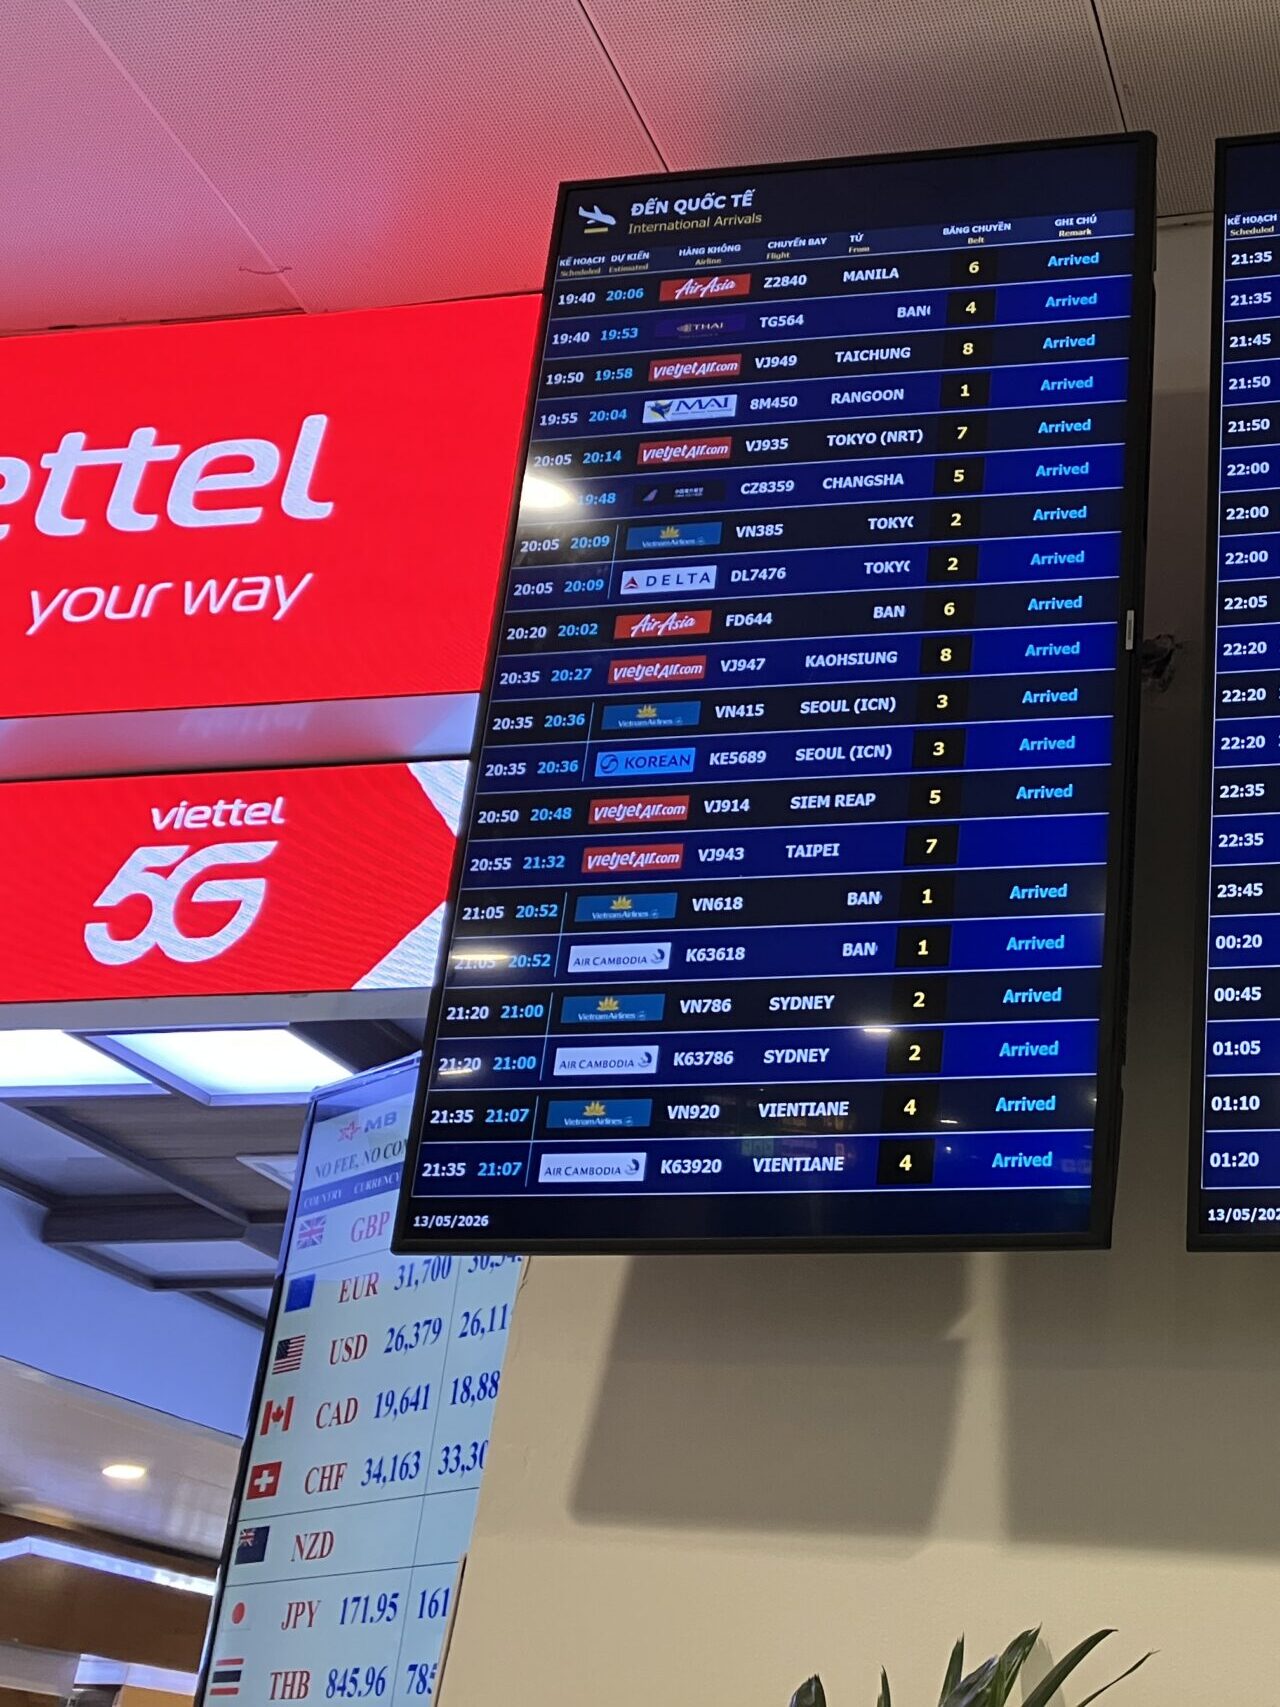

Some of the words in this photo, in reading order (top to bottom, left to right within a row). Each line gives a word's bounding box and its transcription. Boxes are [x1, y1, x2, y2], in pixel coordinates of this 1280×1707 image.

[631, 198, 669, 217] ĐẾN
[673, 192, 727, 215] QUỐC
[730, 188, 756, 208] TẾ
[628, 217, 710, 235] International
[713, 212, 763, 227] Arrivals
[1230, 225, 1275, 237] Scheduled
[1231, 250, 1273, 266] 21:35
[557, 291, 596, 306] 19:40
[605, 287, 644, 302] 20:06
[763, 274, 808, 289] Z2840
[842, 267, 900, 283] MANILA
[968, 260, 980, 274] 6
[1047, 251, 1100, 267] Arrived
[759, 314, 805, 329] TG564
[754, 354, 798, 369] VJ949
[834, 346, 911, 363] TAICHUNG
[749, 395, 798, 410] 8M450
[830, 388, 905, 405] RANGOON
[745, 437, 789, 452] VJ935
[826, 432, 877, 447] TOKYO
[880, 428, 924, 446] (NRT)
[0, 413, 335, 544] ttel
[740, 479, 795, 495] CZ8359
[822, 473, 905, 490] CHANGSHA
[1035, 461, 1090, 477] Arrived
[735, 523, 784, 538] VN385
[513, 581, 554, 596] 20:05
[645, 572, 711, 588] DELTA
[730, 566, 787, 583] DL7476
[26, 580, 175, 636] your
[183, 572, 314, 621] way
[506, 625, 548, 641] 20:20
[725, 612, 773, 627] FD644
[720, 657, 766, 673] VJ947
[805, 650, 898, 668] KAOHSIUNG
[939, 647, 952, 662] 8
[714, 703, 765, 719] VN415
[799, 699, 851, 715] SEOUL
[853, 696, 897, 715] (ICN)
[1221, 687, 1267, 703] 22:20
[709, 750, 767, 766] KE5689
[703, 798, 750, 814] VJ914
[789, 794, 831, 810] SIEM
[834, 792, 877, 808] REAP
[1015, 783, 1073, 800] Arrived
[150, 796, 287, 832] viettel
[469, 857, 512, 872] 20:55
[522, 855, 566, 870] 21:32
[697, 846, 745, 862] VJ943
[785, 842, 841, 859] TAIPEI
[83, 838, 280, 967] 5G
[1216, 882, 1264, 899] 23:45
[691, 896, 744, 912] VN618
[685, 946, 746, 963] K63618
[679, 998, 732, 1014] VN786
[768, 994, 836, 1012] SYDNEY
[673, 1050, 734, 1067] K63786
[667, 1104, 721, 1120] VN920
[758, 1100, 850, 1118] VIENTIANE
[1210, 1095, 1261, 1112] 01:10
[364, 1110, 398, 1133] MB
[314, 1162, 332, 1180] NO
[364, 1147, 381, 1163] NO
[660, 1158, 723, 1175] K63920
[898, 1154, 913, 1172] 4
[991, 1151, 1053, 1168] Arrived
[350, 1210, 391, 1243] GBP
[413, 1214, 489, 1229] 13/05/2026
[338, 1271, 380, 1304] EUR
[394, 1256, 452, 1292] 31,700
[329, 1334, 368, 1366] USD
[383, 1317, 443, 1355] 26,379
[316, 1397, 359, 1429] CAD
[374, 1383, 431, 1421] 19,641
[304, 1462, 348, 1495] CHF
[360, 1450, 421, 1489] 34,163
[290, 1530, 335, 1562] NZD
[281, 1600, 322, 1630] JPY
[339, 1592, 400, 1625] 171.95
[417, 1587, 451, 1620] 161
[269, 1670, 311, 1701] THB
[325, 1665, 389, 1699] 845.96
